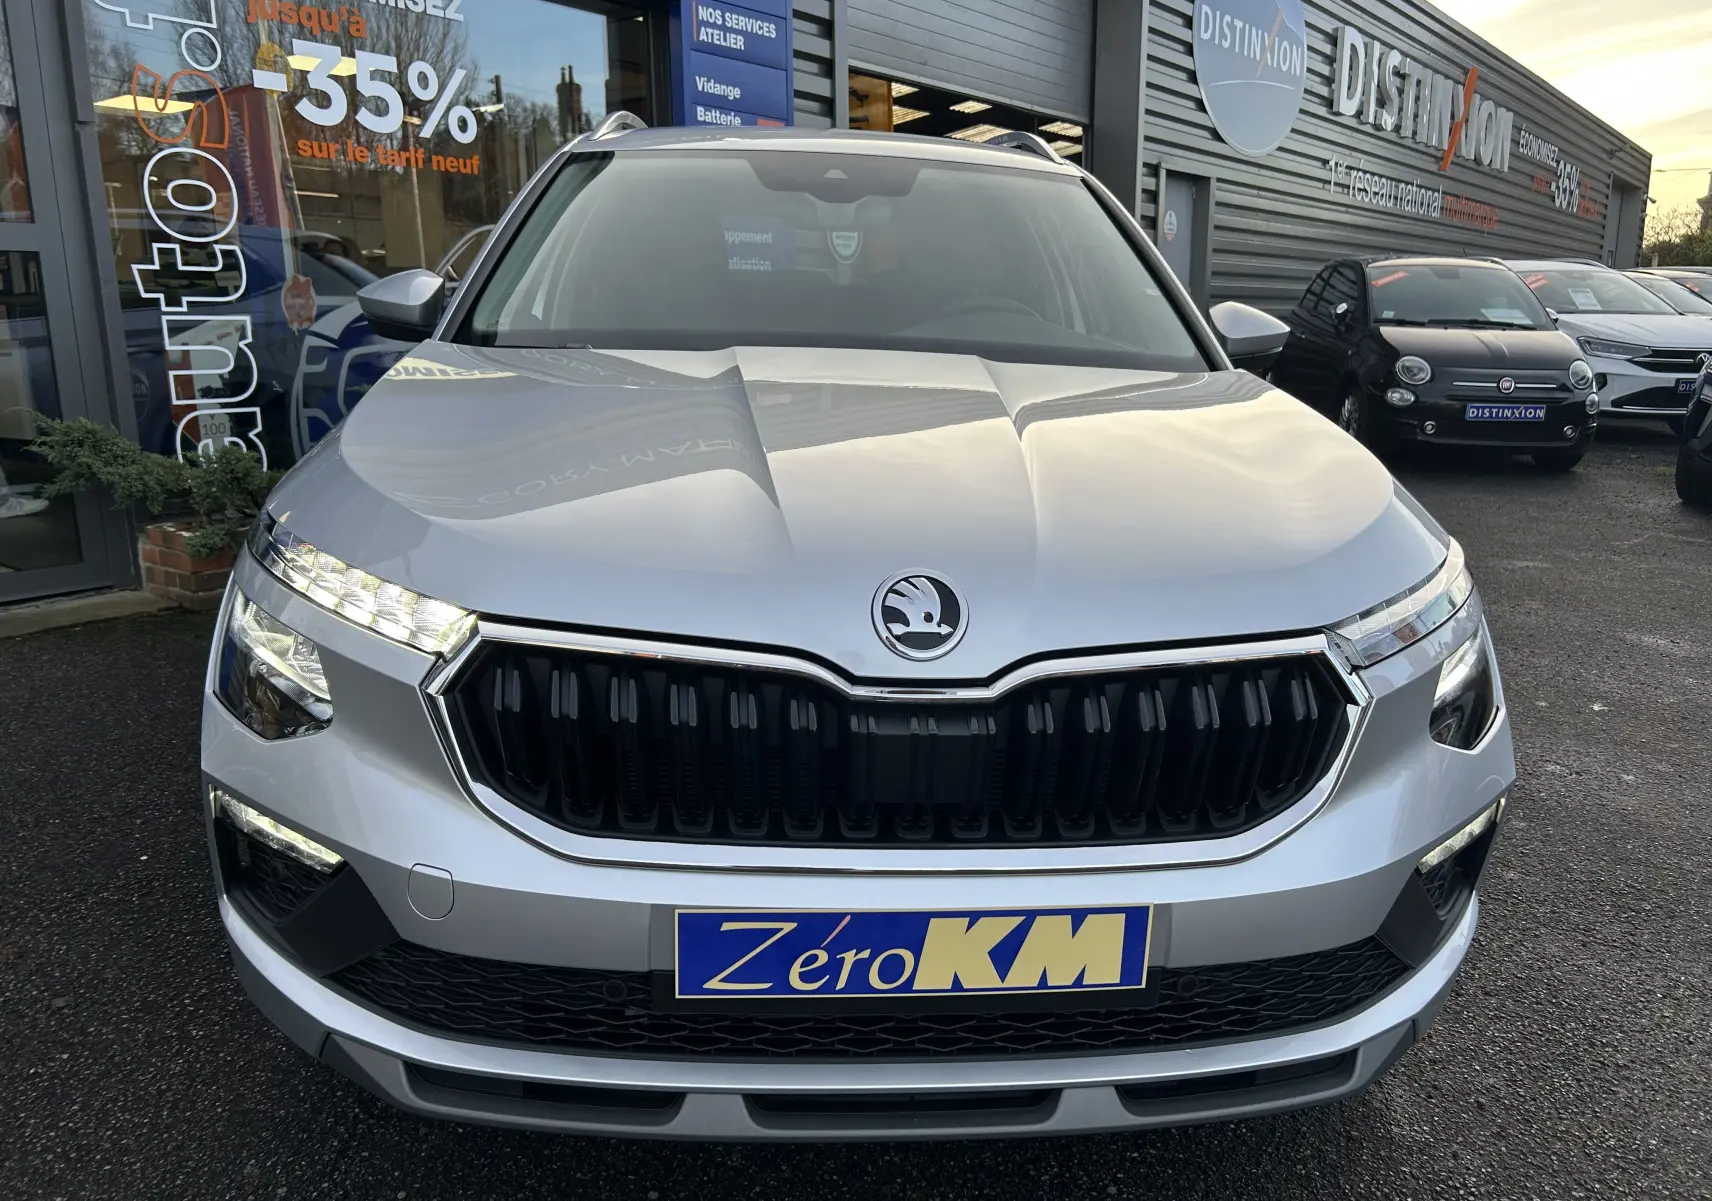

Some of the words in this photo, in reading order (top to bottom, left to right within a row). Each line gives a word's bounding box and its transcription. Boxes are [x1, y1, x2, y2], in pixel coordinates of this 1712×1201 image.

[246, 0, 367, 38] jusqu'à
[698, 5, 723, 25] NOS
[724, 12, 777, 39] SERVICES
[699, 26, 745, 51] ATELIER
[1200, 3, 1302, 78] DISTINXION
[252, 38, 478, 144] -35%
[695, 75, 741, 101] Vidange
[1333, 25, 1514, 172] DISTINXION
[696, 106, 742, 127] Batterie
[297, 139, 340, 160] sur
[346, 140, 371, 164] le
[376, 146, 425, 169] tarif
[431, 154, 480, 176] neuf
[1519, 123, 1559, 168] ÉCONOMISEZ
[1350, 159, 1395, 208] réseau
[1397, 178, 1443, 218] national
[1550, 160, 1580, 213] -35%
[202, 423, 227, 436] 100
[1468, 405, 1545, 421] DISTINXION
